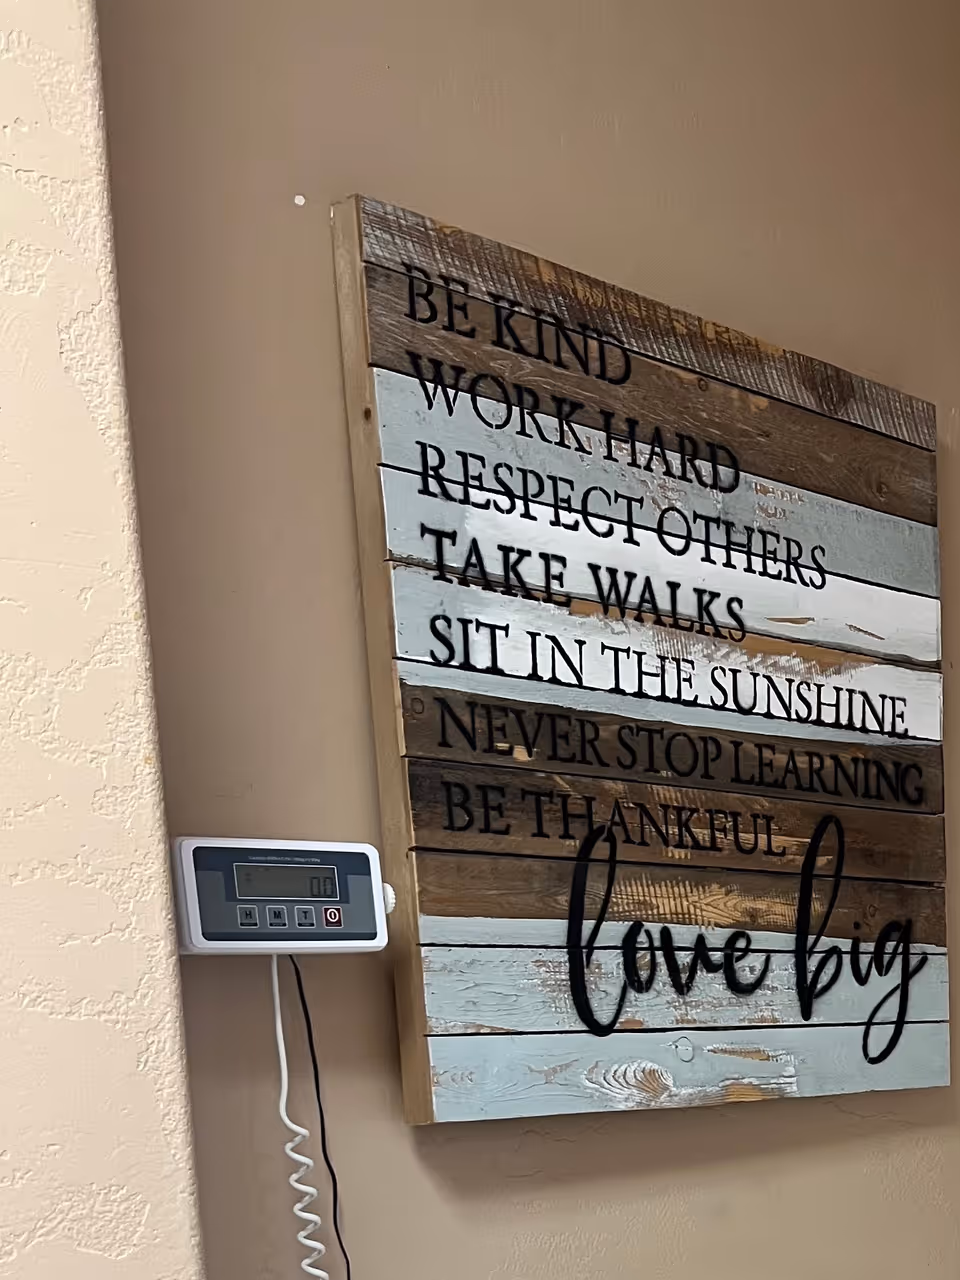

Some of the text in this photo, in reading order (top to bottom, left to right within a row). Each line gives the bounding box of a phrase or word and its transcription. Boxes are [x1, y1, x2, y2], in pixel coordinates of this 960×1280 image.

[402, 261, 632, 385] BE KIND
[405, 350, 740, 493] WORK HARD
[415, 440, 827, 590] RESPECT OTHERS
[420, 522, 747, 643] TAKE WALKS
[429, 614, 909, 738] SIT IN THE SUNSHINE
[433, 697, 924, 805] NEVER STOP LEARNING
[440, 781, 786, 856] BE THANKFUL
[244, 910, 253, 919] H
[273, 911, 282, 920] M
[302, 910, 309, 919] T
[567, 813, 929, 1066] love big
